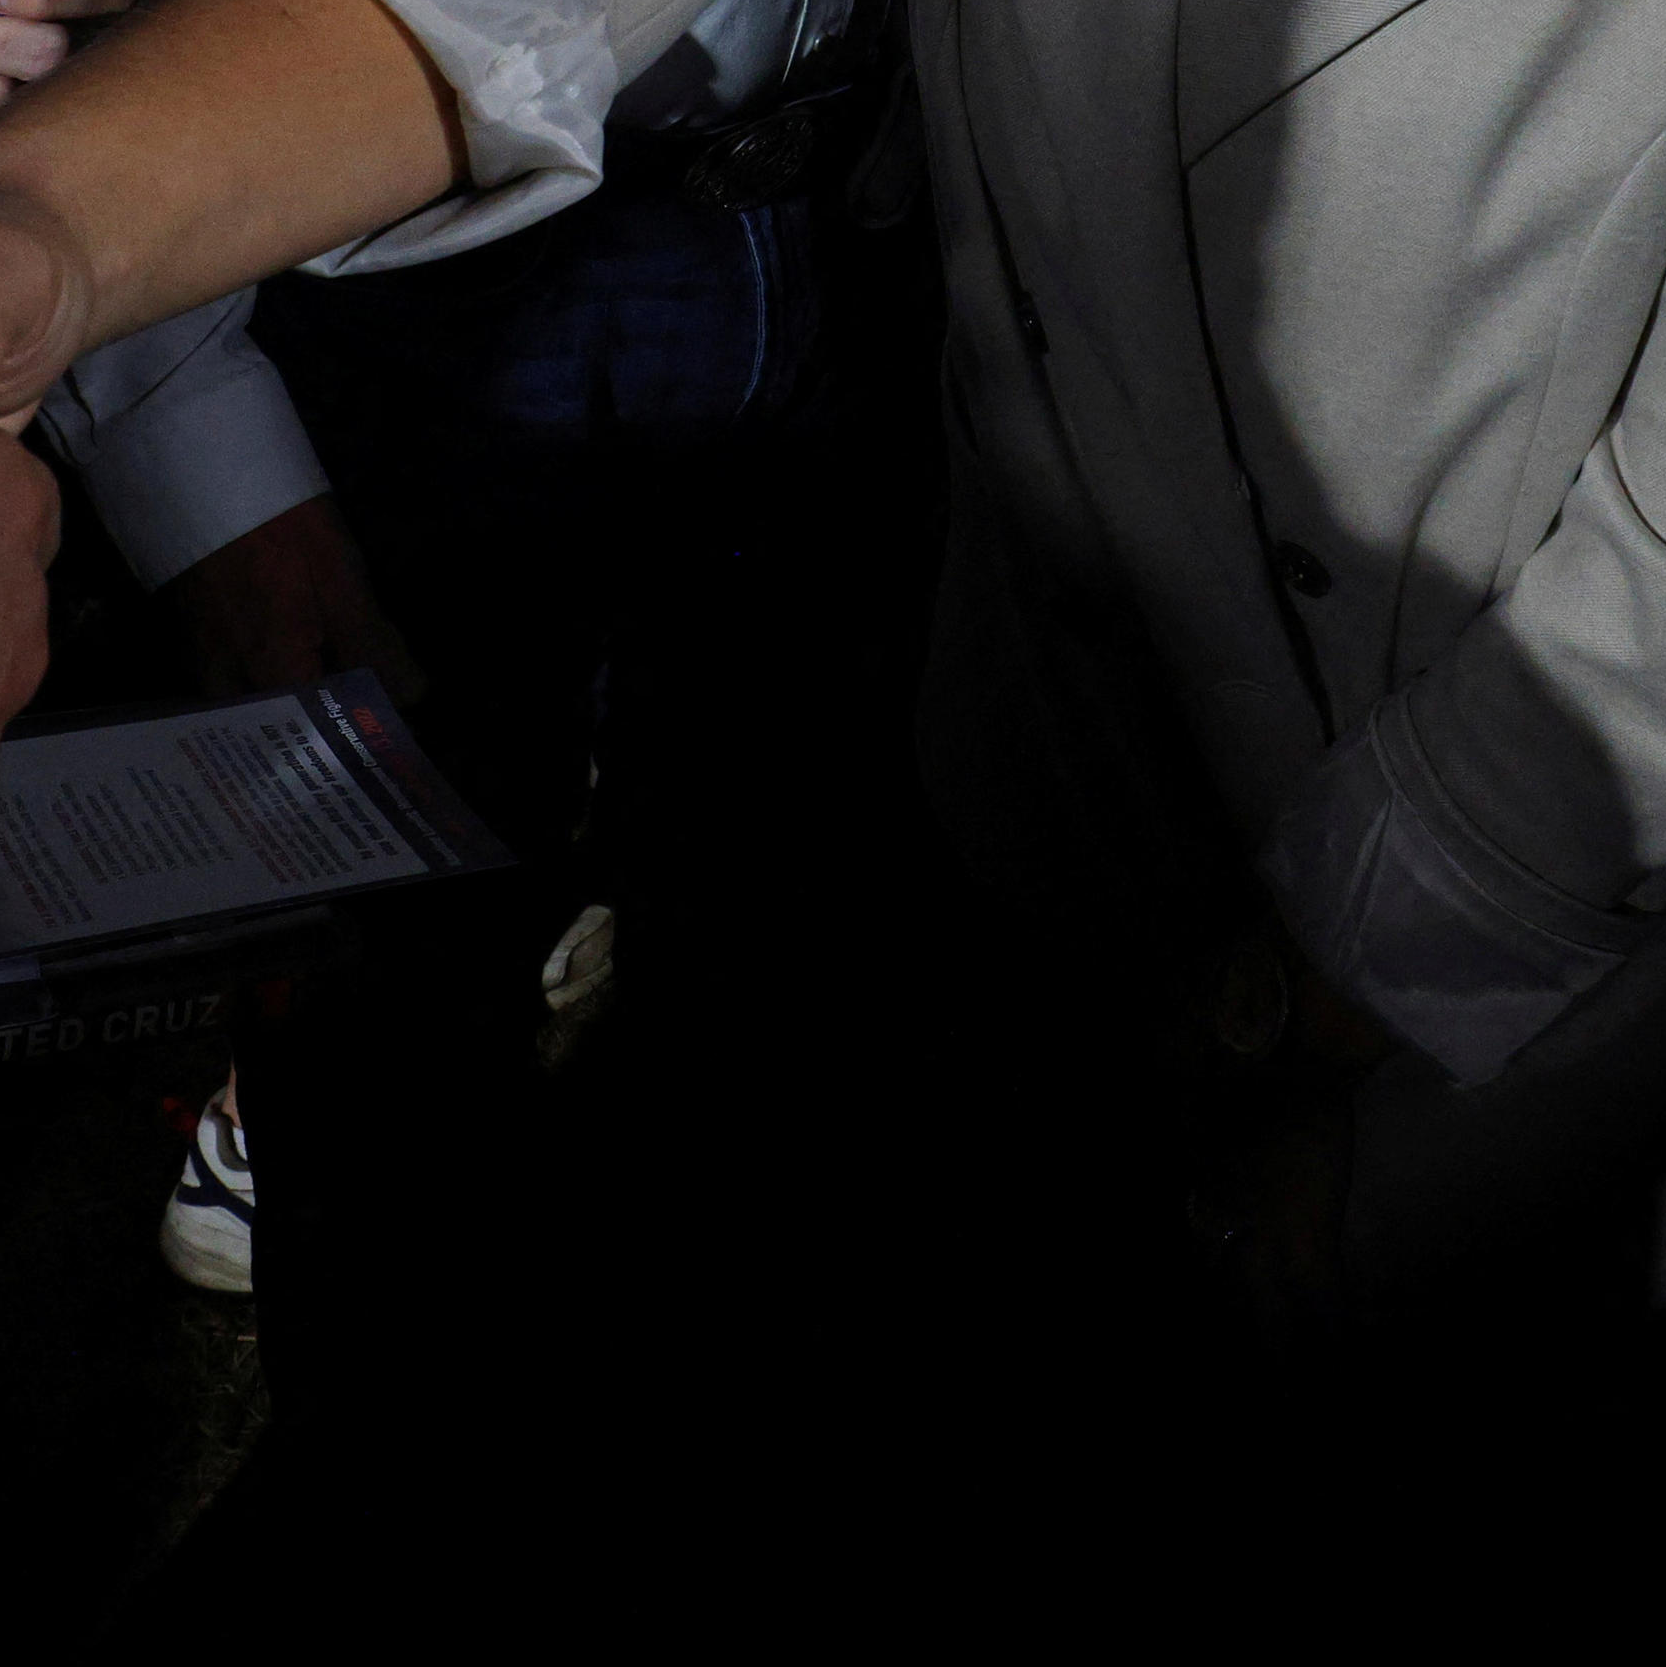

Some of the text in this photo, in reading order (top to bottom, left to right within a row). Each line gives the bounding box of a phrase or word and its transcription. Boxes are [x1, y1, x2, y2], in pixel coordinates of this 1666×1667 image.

[316, 688, 346, 719] Fighter
[300, 745, 337, 783] freedoms
[331, 717, 380, 767] Conservative
[280, 748, 323, 792] generation
[102, 994, 223, 1045] CRUZ
